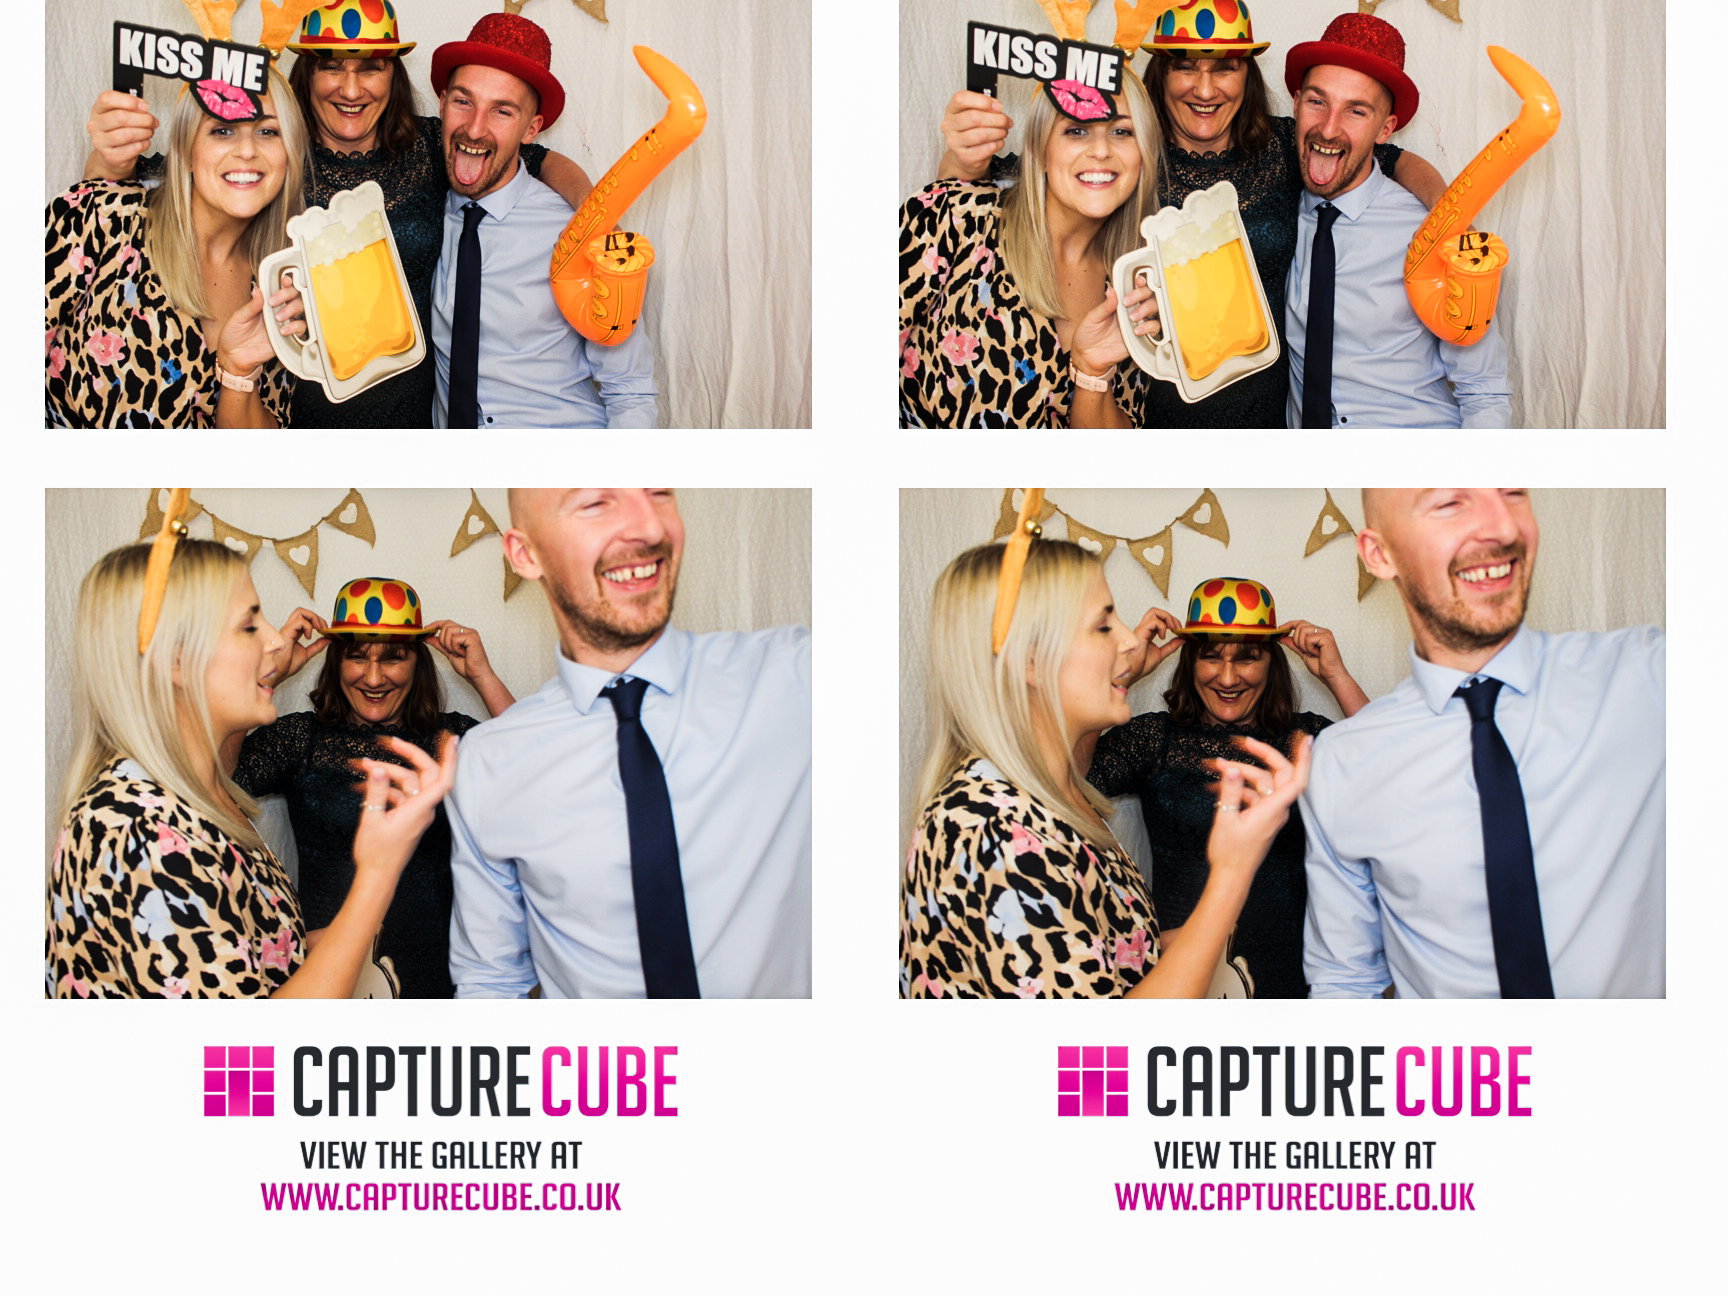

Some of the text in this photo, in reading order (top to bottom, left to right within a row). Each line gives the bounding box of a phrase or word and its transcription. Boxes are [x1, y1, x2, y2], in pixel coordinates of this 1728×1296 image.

[119, 27, 265, 91] KISS ME
[973, 27, 1119, 91] KISS ME
